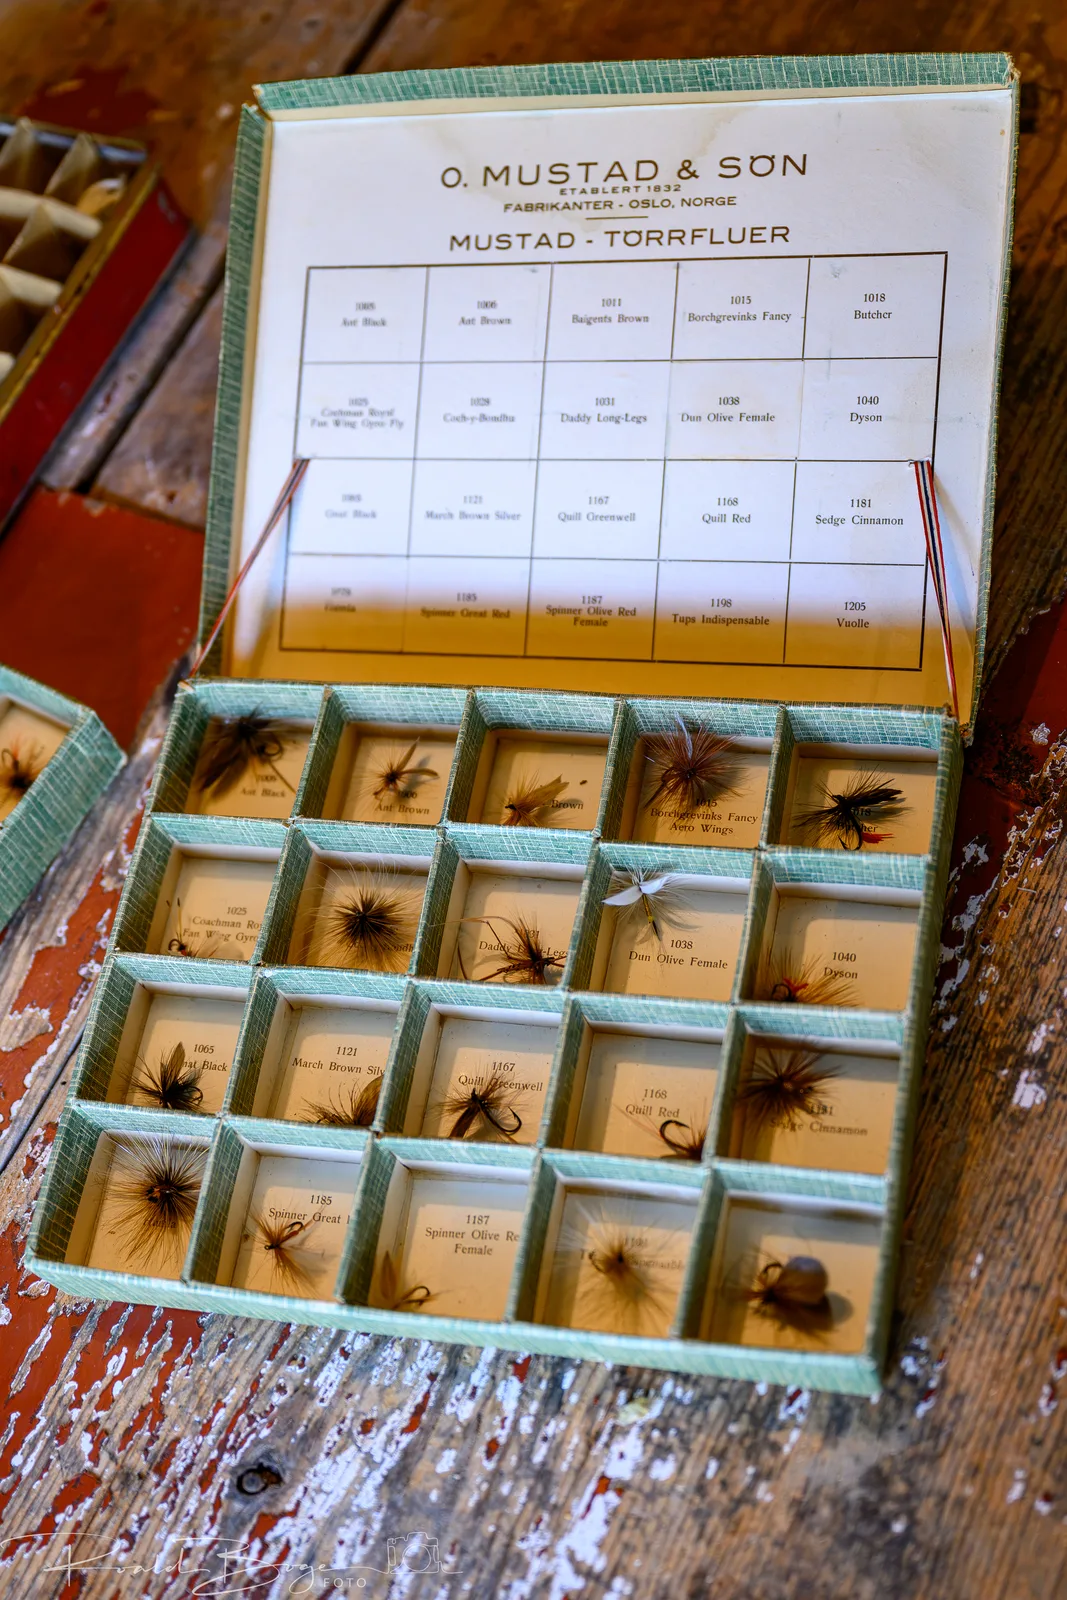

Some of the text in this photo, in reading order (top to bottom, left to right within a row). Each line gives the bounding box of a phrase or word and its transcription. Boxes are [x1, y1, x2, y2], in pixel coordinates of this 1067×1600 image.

[440, 153, 808, 189] O. MUSTAD & SÖN
[559, 184, 682, 196] ETABLERT 1832
[503, 200, 614, 213] FABRIKANTER
[628, 198, 675, 210] OSLO,
[680, 196, 737, 208] NORGE
[449, 232, 576, 252] MUSTAD
[603, 225, 790, 248] TÖRRFLUER
[601, 298, 622, 307] 1011
[730, 295, 752, 305] 1015
[863, 293, 886, 303] 1018
[480, 316, 512, 325] Brown
[571, 313, 650, 325] Baigents Brown
[687, 311, 792, 324] Borchgrevinks Fancy
[853, 309, 893, 320] Butcher
[594, 397, 615, 406] 1031
[717, 396, 740, 406] 1038
[856, 395, 880, 406] 1040
[560, 413, 647, 425] Daddy Long-Legs
[680, 412, 776, 423] Dun Olive Female
[849, 412, 883, 425] Dyson
[587, 496, 609, 506] 1167
[716, 496, 739, 506] 1168
[849, 498, 872, 508] 1181
[458, 511, 490, 521] Brown
[494, 511, 521, 521] Silver
[557, 511, 637, 523] Quill Greenwell
[701, 513, 752, 525] Quill Red
[815, 515, 904, 527] Sedge Cinnamon
[581, 595, 603, 605] 1187
[710, 598, 732, 608] 1198
[545, 604, 637, 617] Spinner Olive Red
[844, 601, 867, 612] 1205
[573, 616, 609, 627] Female
[671, 613, 771, 626] Tups Indispensable
[836, 617, 870, 629] Vuolle
[375, 803, 430, 815] Ant Brown
[551, 799, 584, 810] Brown
[727, 812, 759, 825] Fancy
[669, 821, 734, 836] Aero Wings
[226, 906, 248, 916] 1025
[192, 915, 242, 929] Coachman
[182, 927, 200, 938] Fan
[478, 940, 513, 953] Daddy
[669, 939, 694, 950] 1038
[628, 950, 729, 970] Dun Olive Female
[832, 951, 857, 963] 1040
[823, 966, 858, 980] Dyson
[193, 1043, 215, 1054] 1065
[336, 1046, 358, 1057] 1121
[184, 1060, 228, 1072] nat Black
[291, 1057, 324, 1070] March
[328, 1061, 362, 1074] Brown
[492, 1061, 516, 1072] 1167
[458, 1074, 484, 1087] Quill
[643, 1088, 668, 1100] 1168
[625, 1103, 680, 1119] Quill Red
[809, 1121, 868, 1137] Cinnamon
[310, 1194, 333, 1206] 1185
[268, 1207, 308, 1221] Spinner
[312, 1211, 341, 1224] Great
[466, 1214, 490, 1226] 1187
[424, 1226, 466, 1240] Spinner
[471, 1228, 500, 1241] Olive
[454, 1242, 493, 1256] Female
